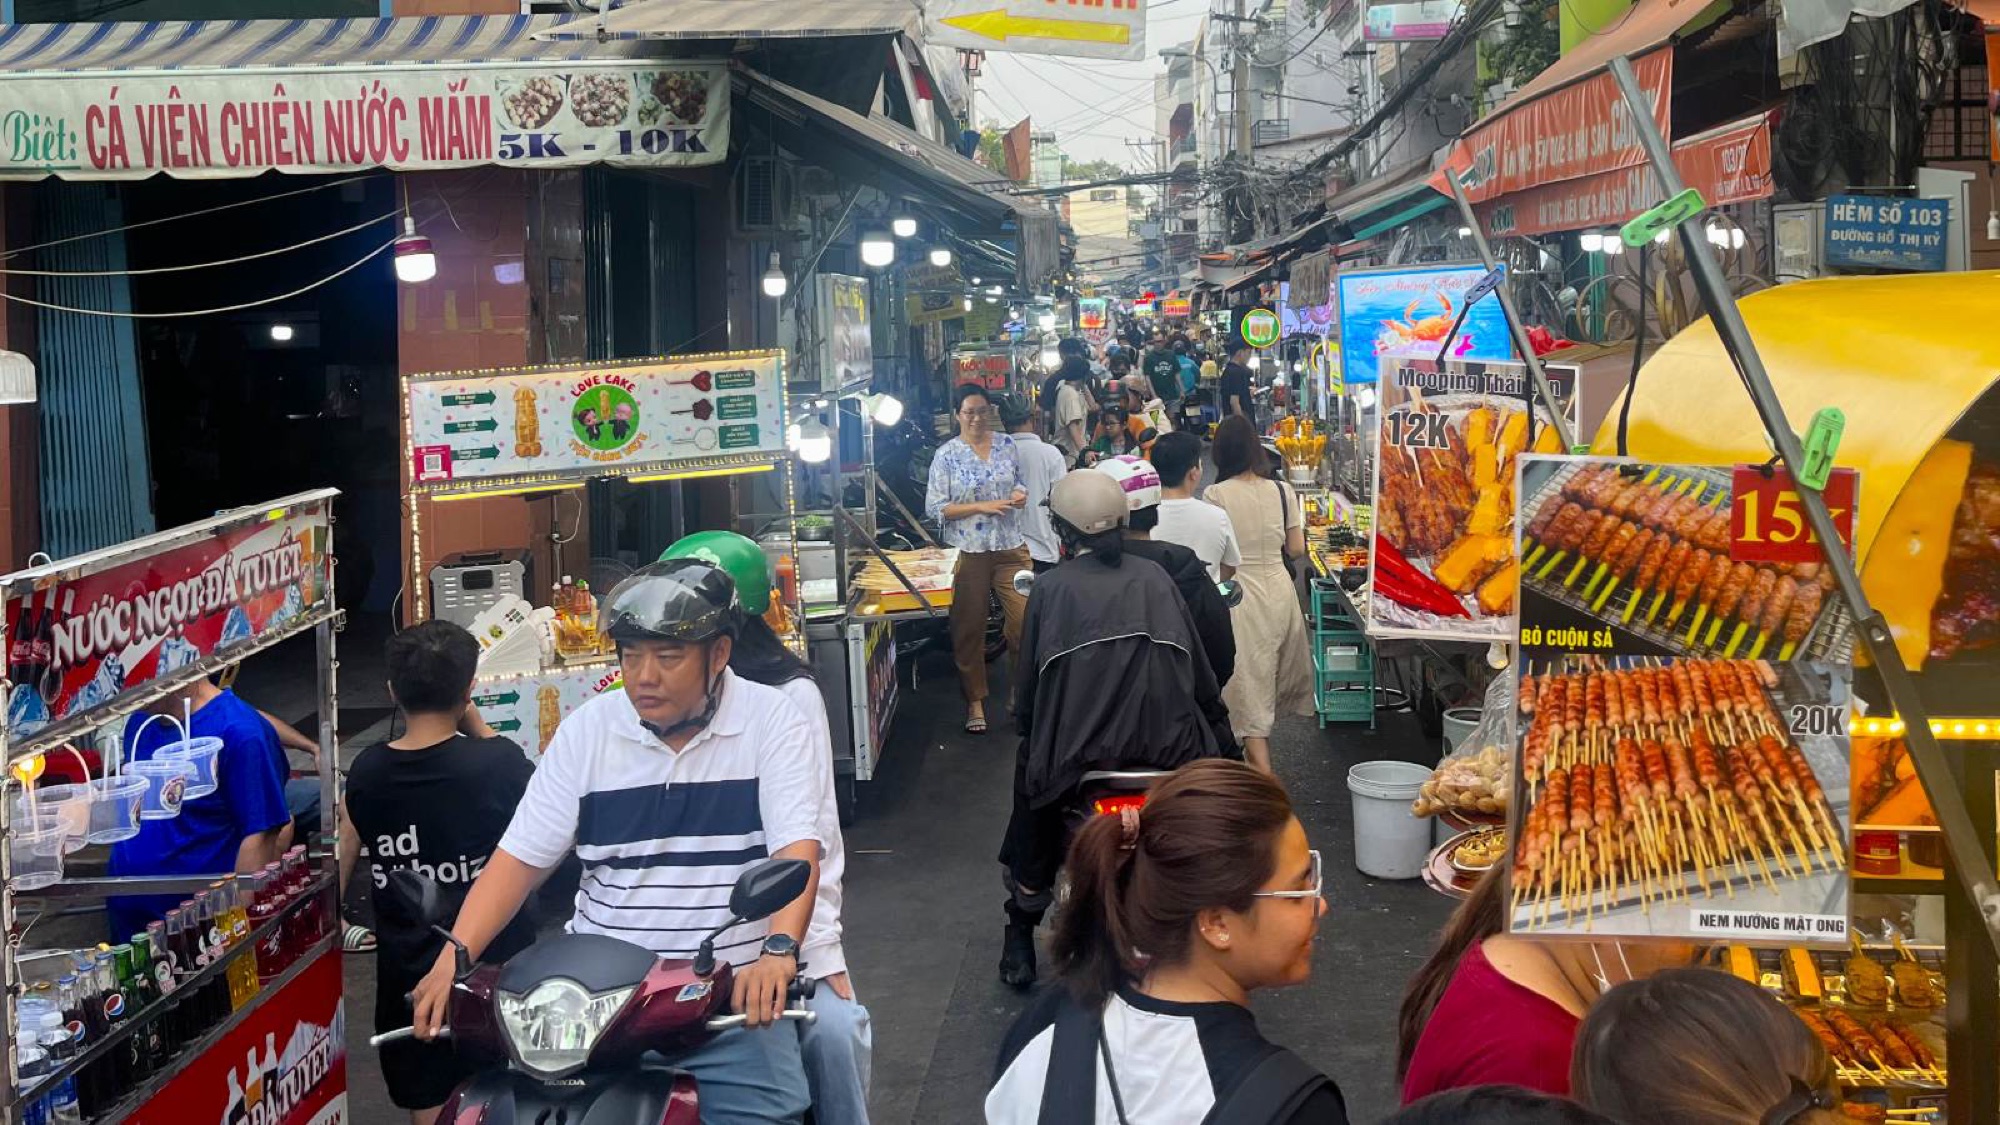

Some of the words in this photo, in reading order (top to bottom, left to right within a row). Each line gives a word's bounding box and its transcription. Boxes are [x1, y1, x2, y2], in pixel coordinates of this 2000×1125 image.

[86, 85, 130, 170] CÁ
[135, 85, 212, 169] VIÊN
[220, 83, 316, 167] CHIÊN
[324, 80, 410, 164] NƯỚC
[418, 78, 493, 161] MẮM
[498, 133, 569, 159] 5K
[616, 128, 711, 155] 10K
[1833, 198, 1873, 222] HẺM
[1878, 200, 1905, 224] SỐ
[1909, 208, 1942, 226] 103
[570, 375, 601, 397] LOVE
[605, 374, 636, 393] CAKE
[1398, 368, 1478, 393] Mooping
[1483, 371, 1522, 395] Thái
[1388, 412, 1451, 450] 12K
[52, 592, 133, 668] NƯỚC
[134, 577, 202, 636] NGỌT
[203, 552, 238, 612] ĐÁ
[241, 526, 303, 597] TUYẾT
[1520, 625, 1542, 645] BÒ
[1546, 626, 1589, 650] CUỘN
[1790, 704, 1845, 737] 20K
[1699, 913, 1730, 928] NEM
[1733, 912, 1780, 930] NƯỚNG
[1783, 914, 1813, 935] MẬT
[1816, 918, 1845, 933] ONG
[278, 1026, 330, 1114] TUYẾT
